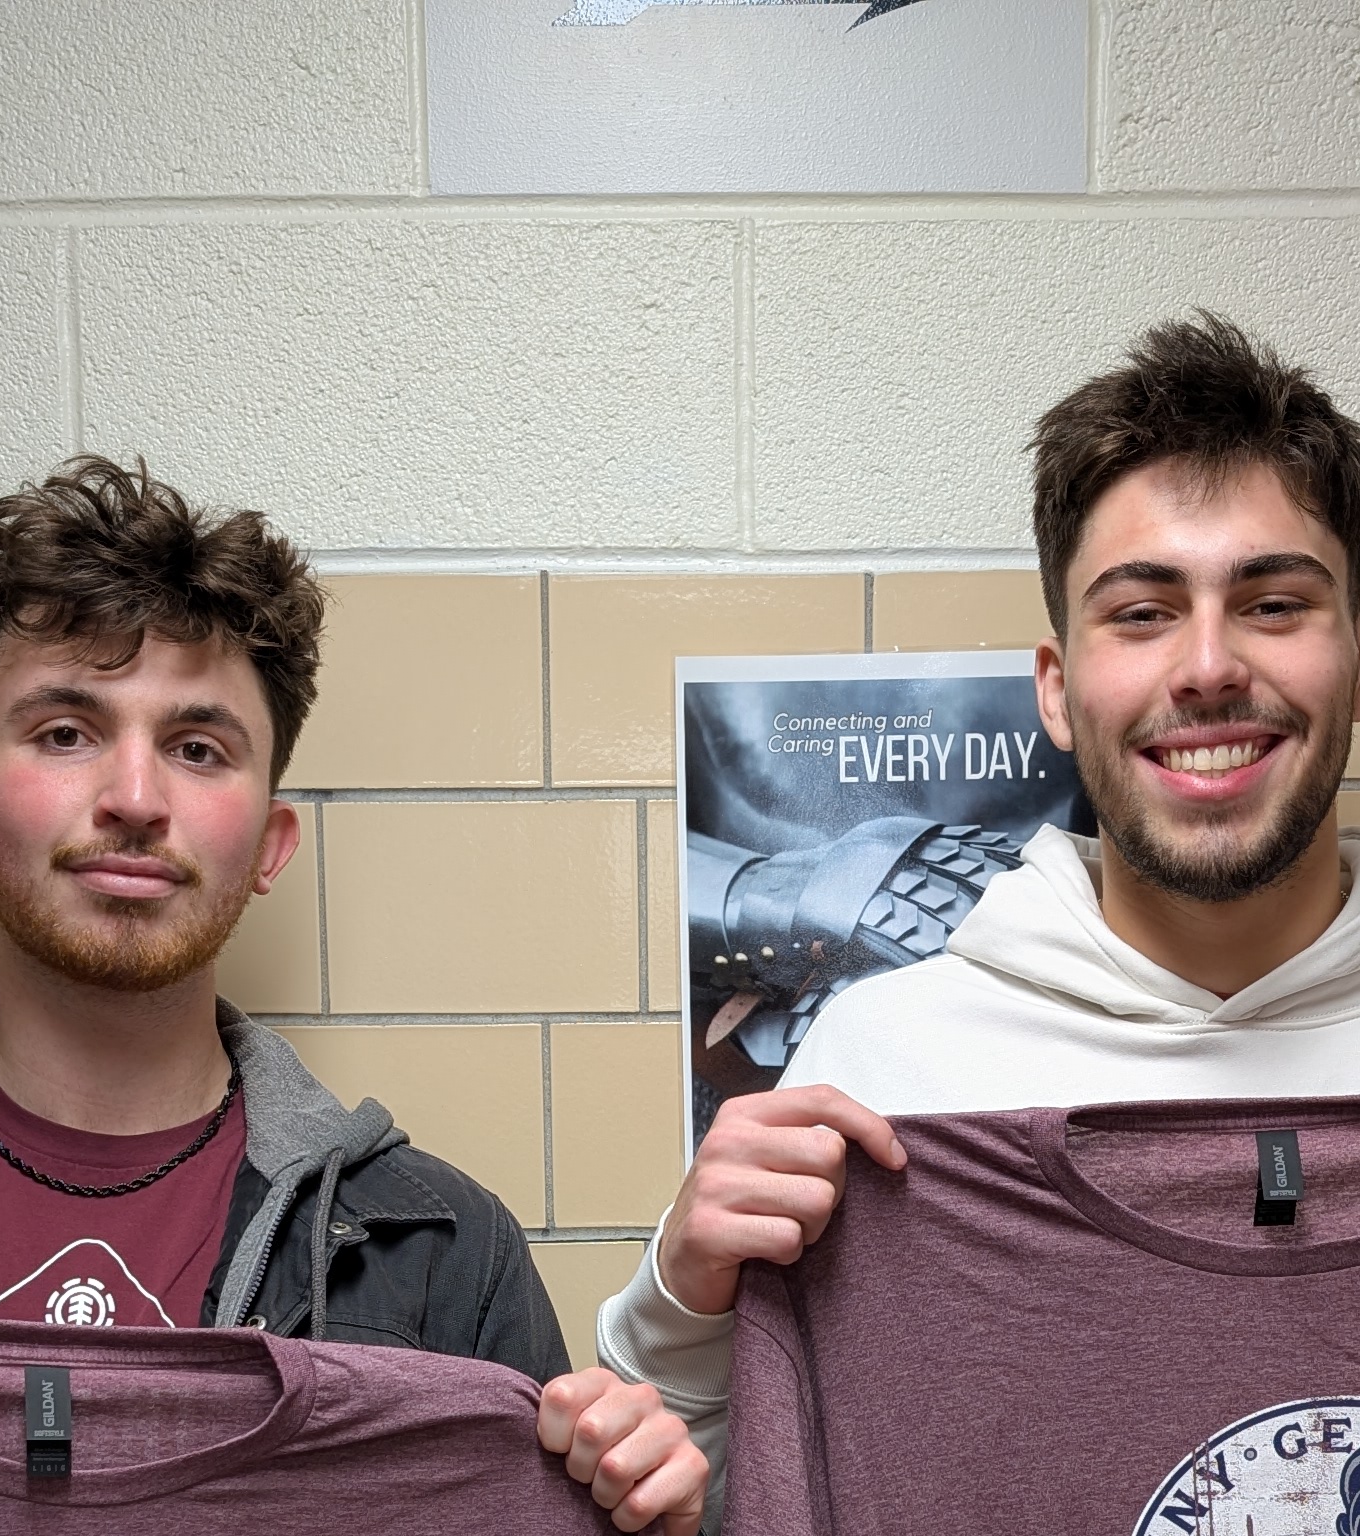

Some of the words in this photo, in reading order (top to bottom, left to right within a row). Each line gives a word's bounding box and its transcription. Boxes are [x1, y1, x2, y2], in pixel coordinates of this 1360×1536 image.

[773, 711, 887, 733] Connecting
[893, 709, 933, 729] and
[768, 735, 835, 757] Caring
[839, 733, 955, 783] EVERY
[965, 731, 1046, 780] DAY.
[1272, 1144, 1288, 1188] GILDAN
[41, 1379, 55, 1427] GILDAN
